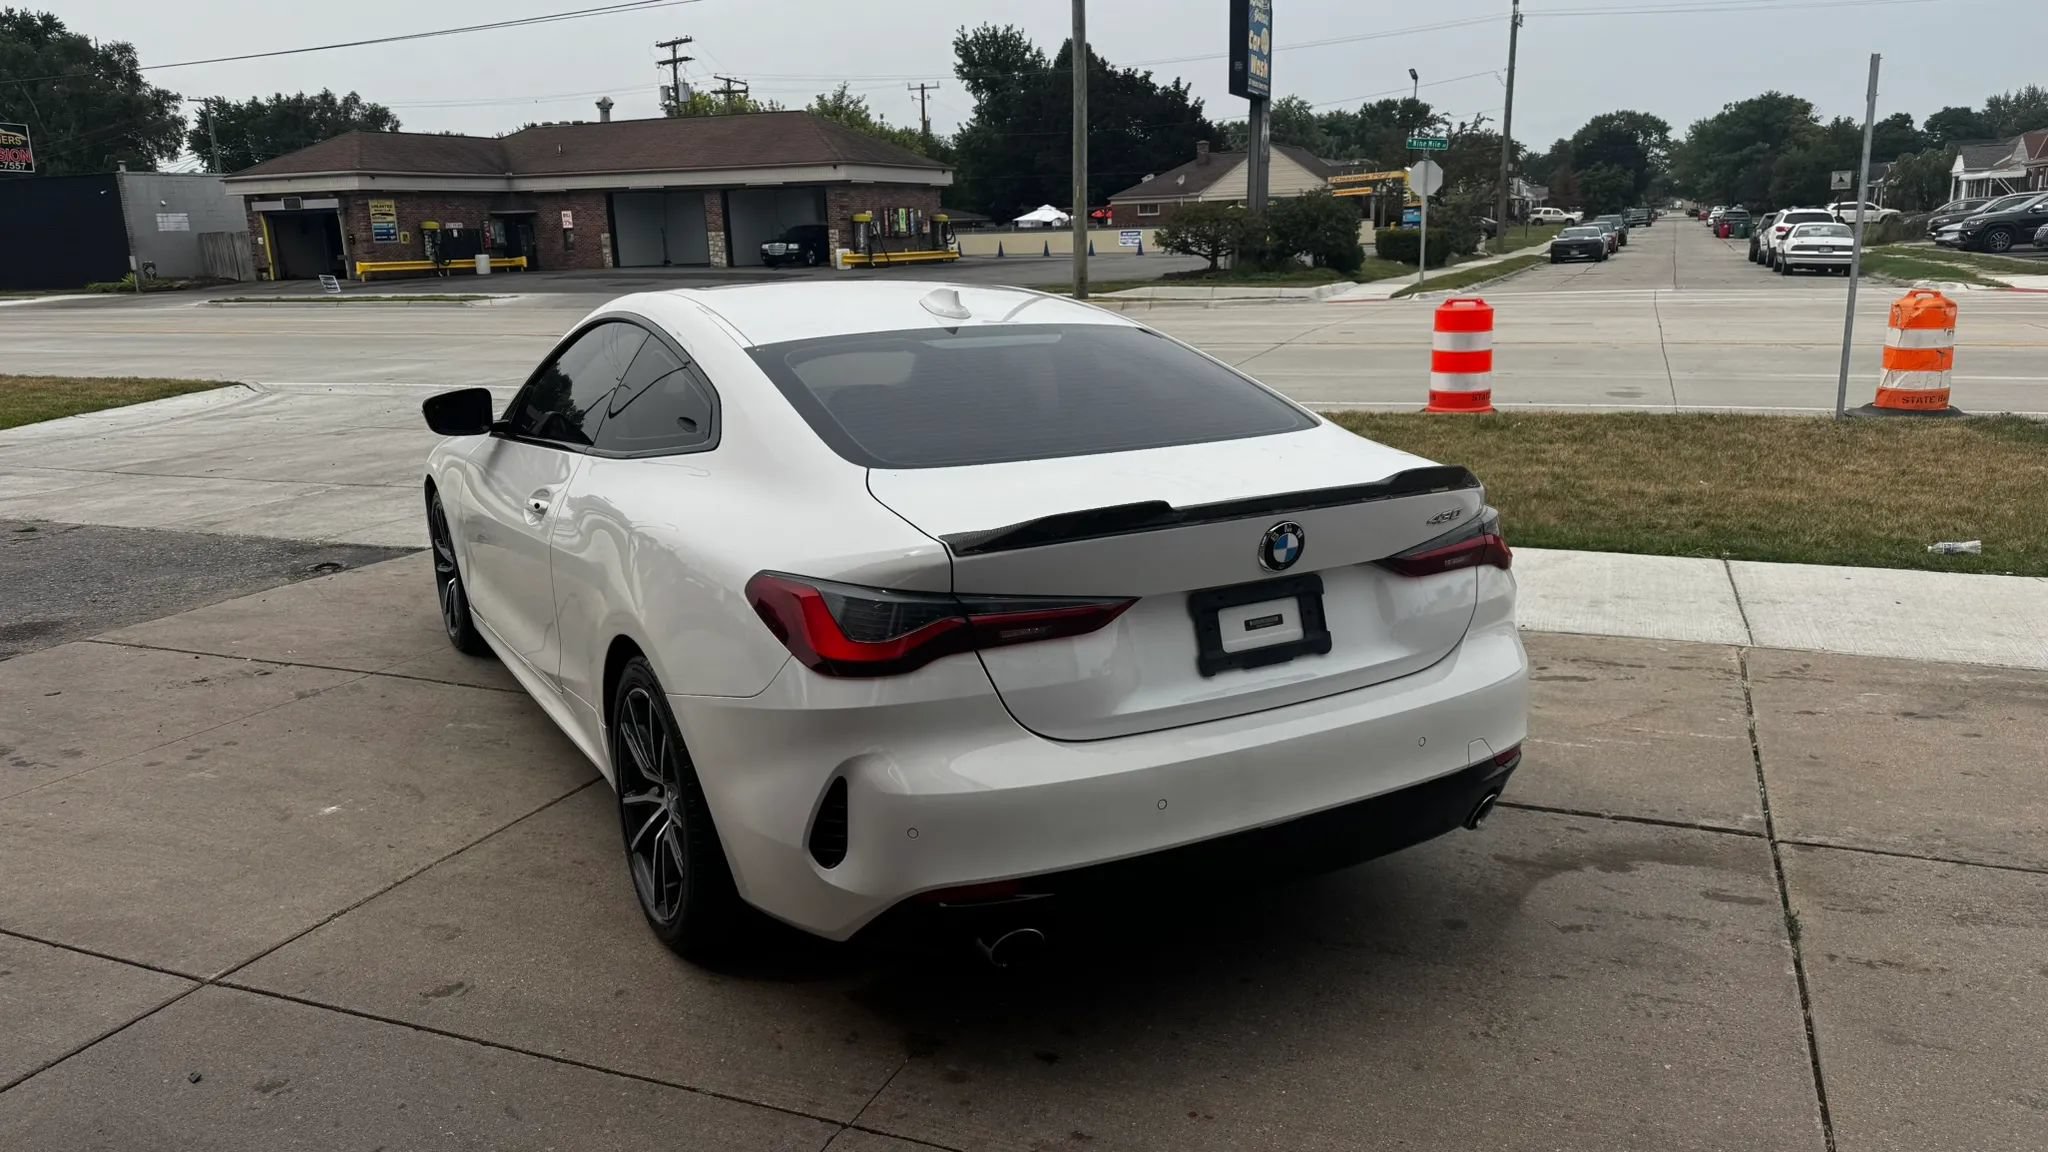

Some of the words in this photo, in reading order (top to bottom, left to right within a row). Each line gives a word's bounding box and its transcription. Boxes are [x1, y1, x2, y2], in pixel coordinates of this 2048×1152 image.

[1249, 30, 1261, 52] Car
[1250, 54, 1269, 78] Wash
[0, 135, 22, 145] ERS
[1412, 140, 1428, 148] Nine
[1429, 140, 1441, 148] Mile
[1902, 395, 1936, 404] STATE
